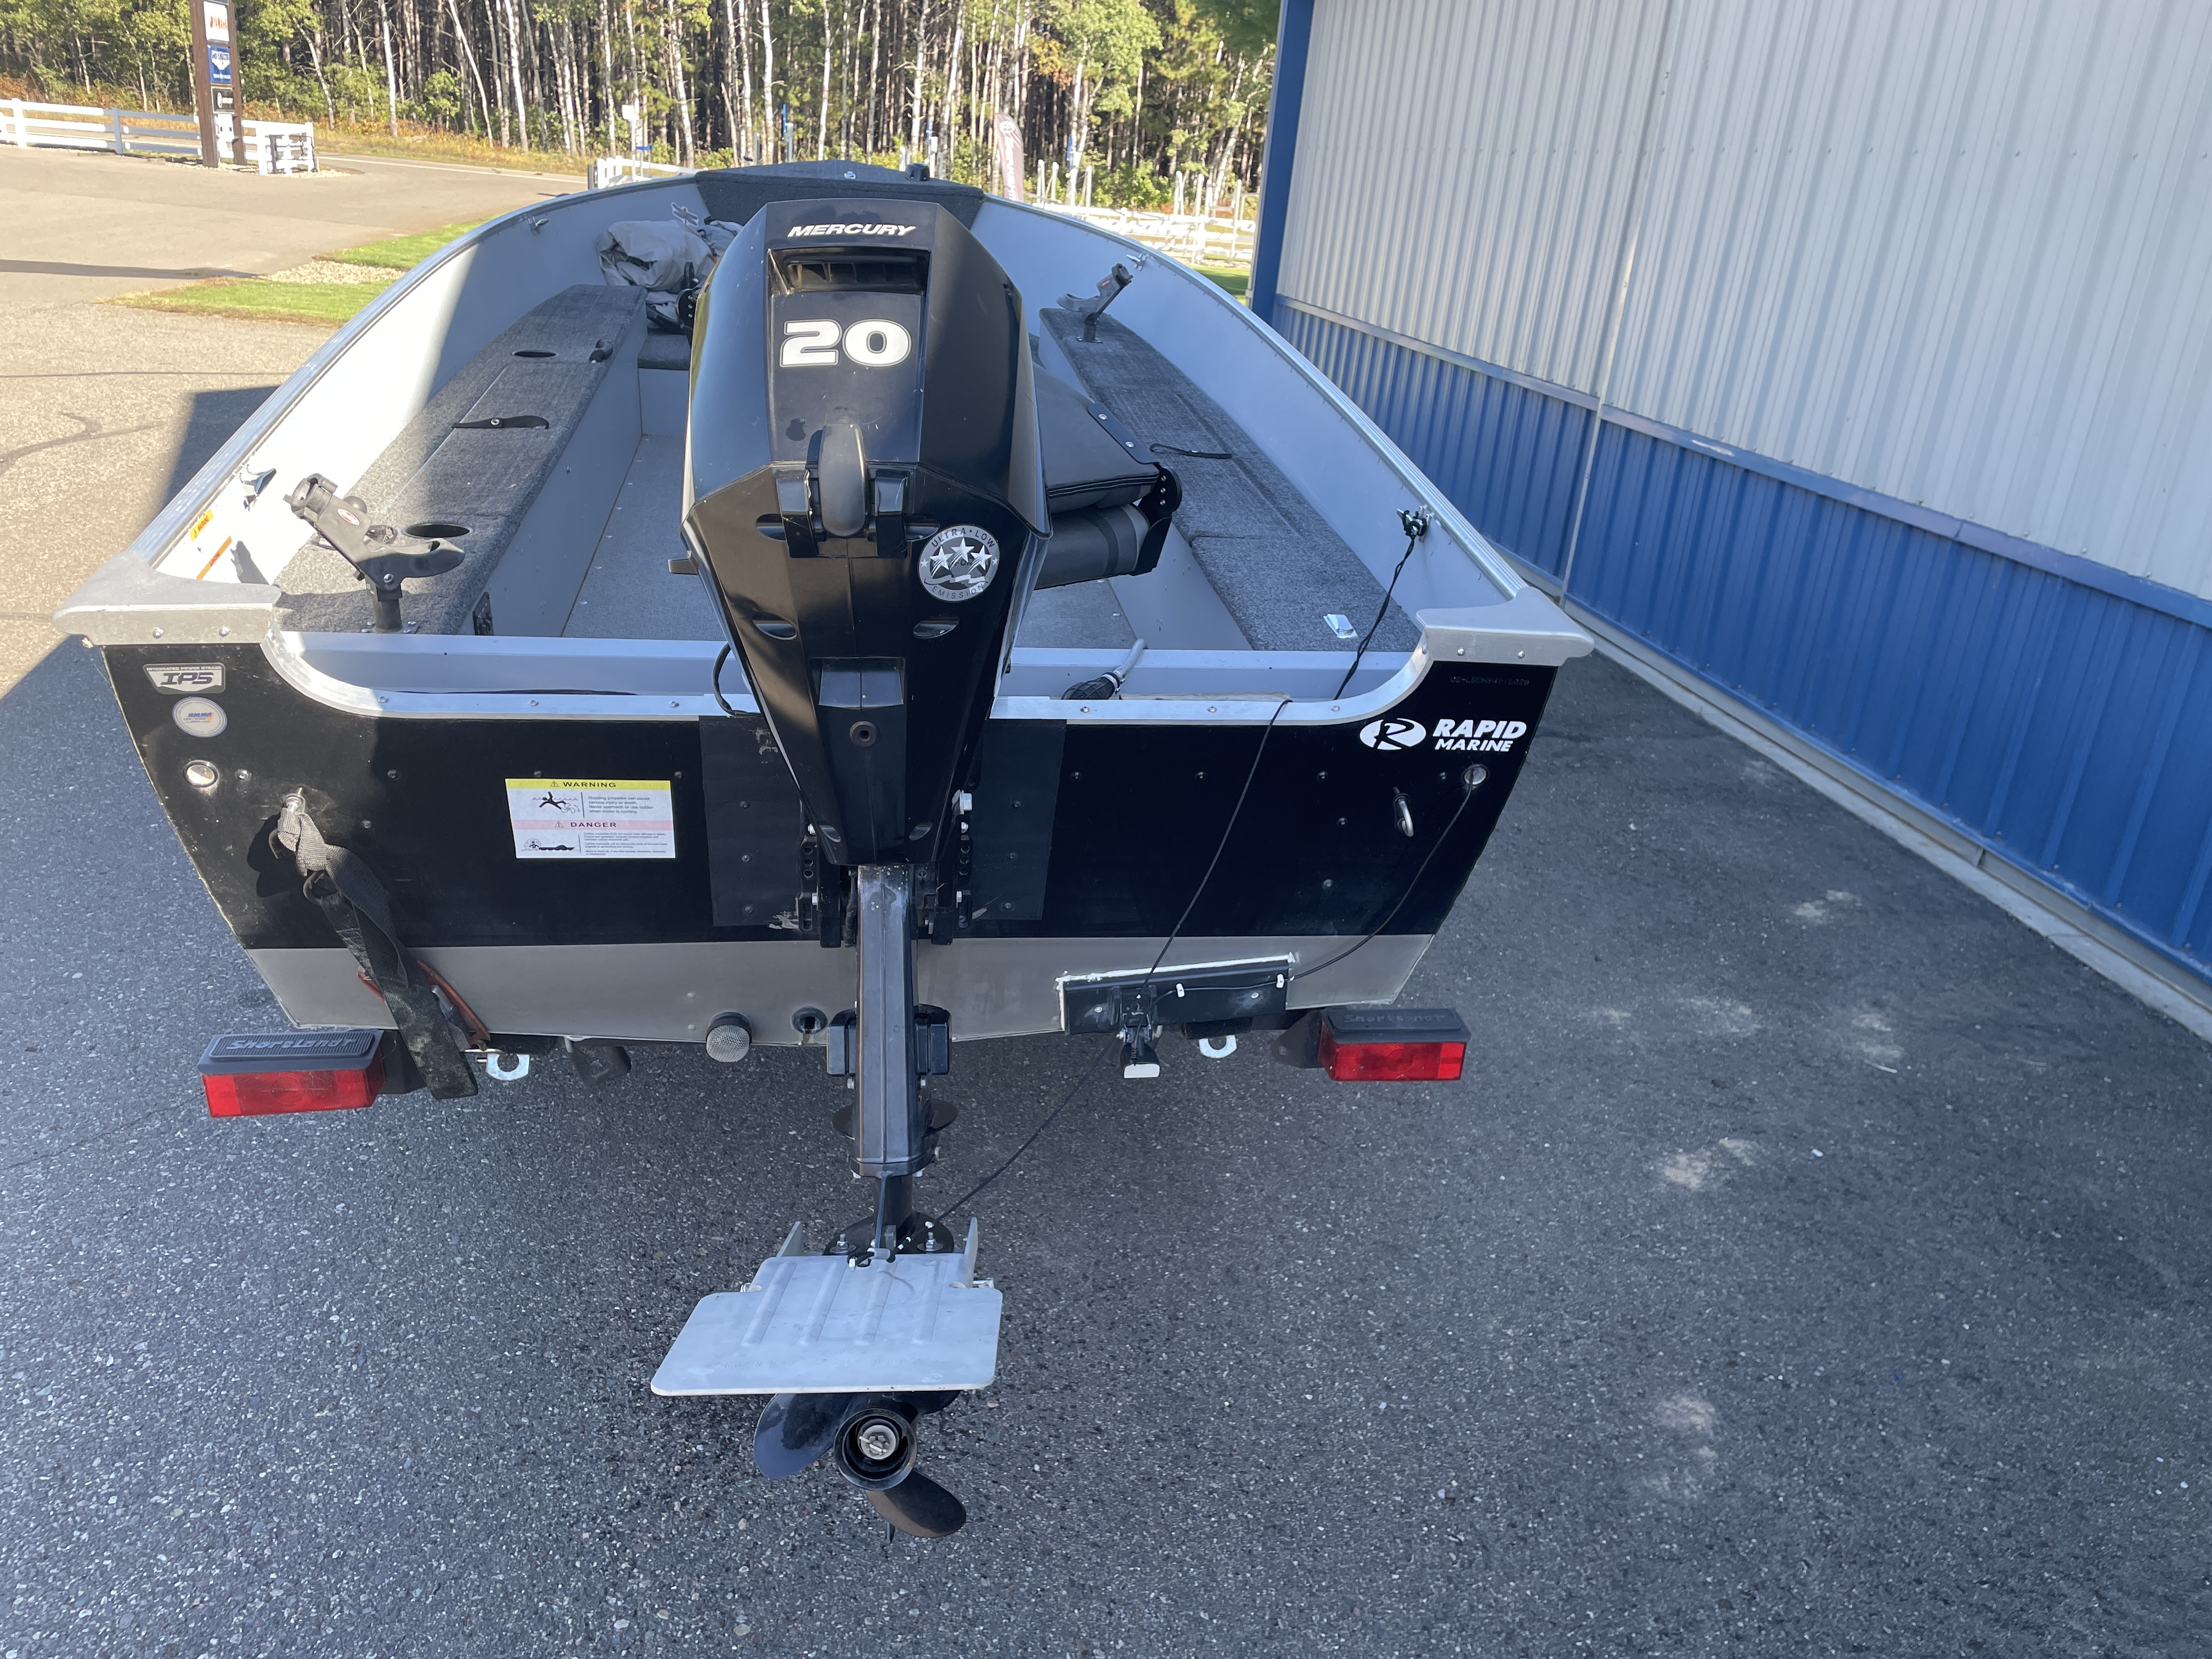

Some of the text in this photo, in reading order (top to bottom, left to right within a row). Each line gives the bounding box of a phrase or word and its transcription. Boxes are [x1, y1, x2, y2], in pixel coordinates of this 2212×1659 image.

[787, 224, 917, 238] MERCURY
[780, 319, 912, 368] 20
[932, 527, 995, 548] ULTRA LOW
[932, 583, 984, 599] EMISSION
[160, 672, 214, 685] IPS
[1432, 718, 1527, 739] RAPID
[1435, 738, 1514, 752] MARINE
